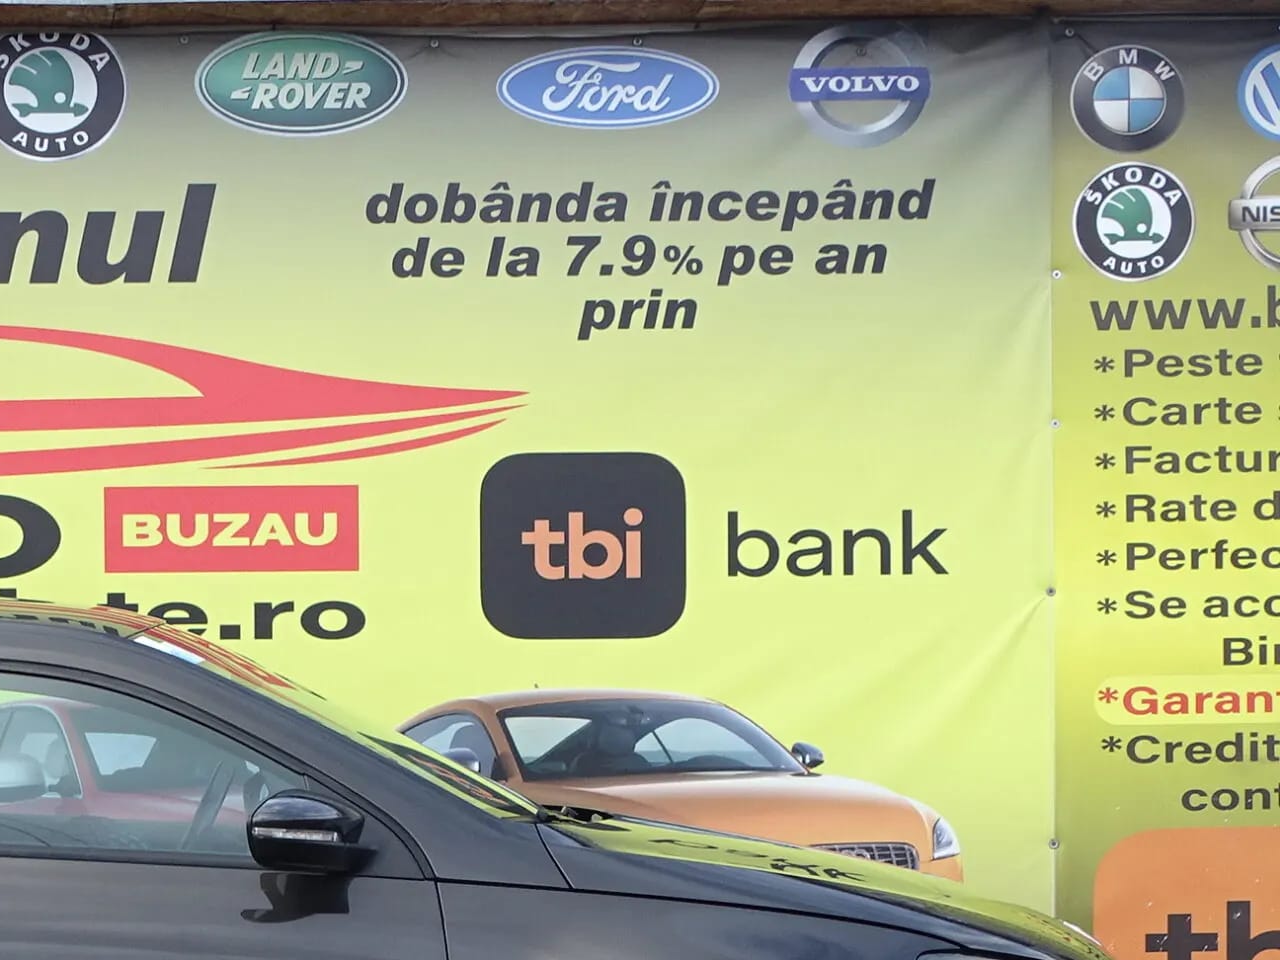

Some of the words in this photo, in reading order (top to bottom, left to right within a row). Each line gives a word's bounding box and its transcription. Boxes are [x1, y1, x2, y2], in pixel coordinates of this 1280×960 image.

[542, 59, 673, 112] Ford
[799, 75, 920, 93] VOLVO
[1083, 49, 1176, 83] BMW
[12, 131, 89, 152] AUTO
[365, 182, 628, 224] dobânda
[650, 178, 937, 231] începând
[392, 237, 465, 278] de
[486, 237, 540, 277] la
[566, 235, 704, 277] 7.9%
[717, 245, 794, 286] pe
[815, 244, 888, 275] an
[1102, 255, 1165, 275] AUTO
[577, 289, 698, 340] prin
[122, 512, 338, 547] BUZAU
[521, 508, 644, 580] tbi
[727, 510, 949, 577] bank
[1123, 686, 1280, 715] Garan
